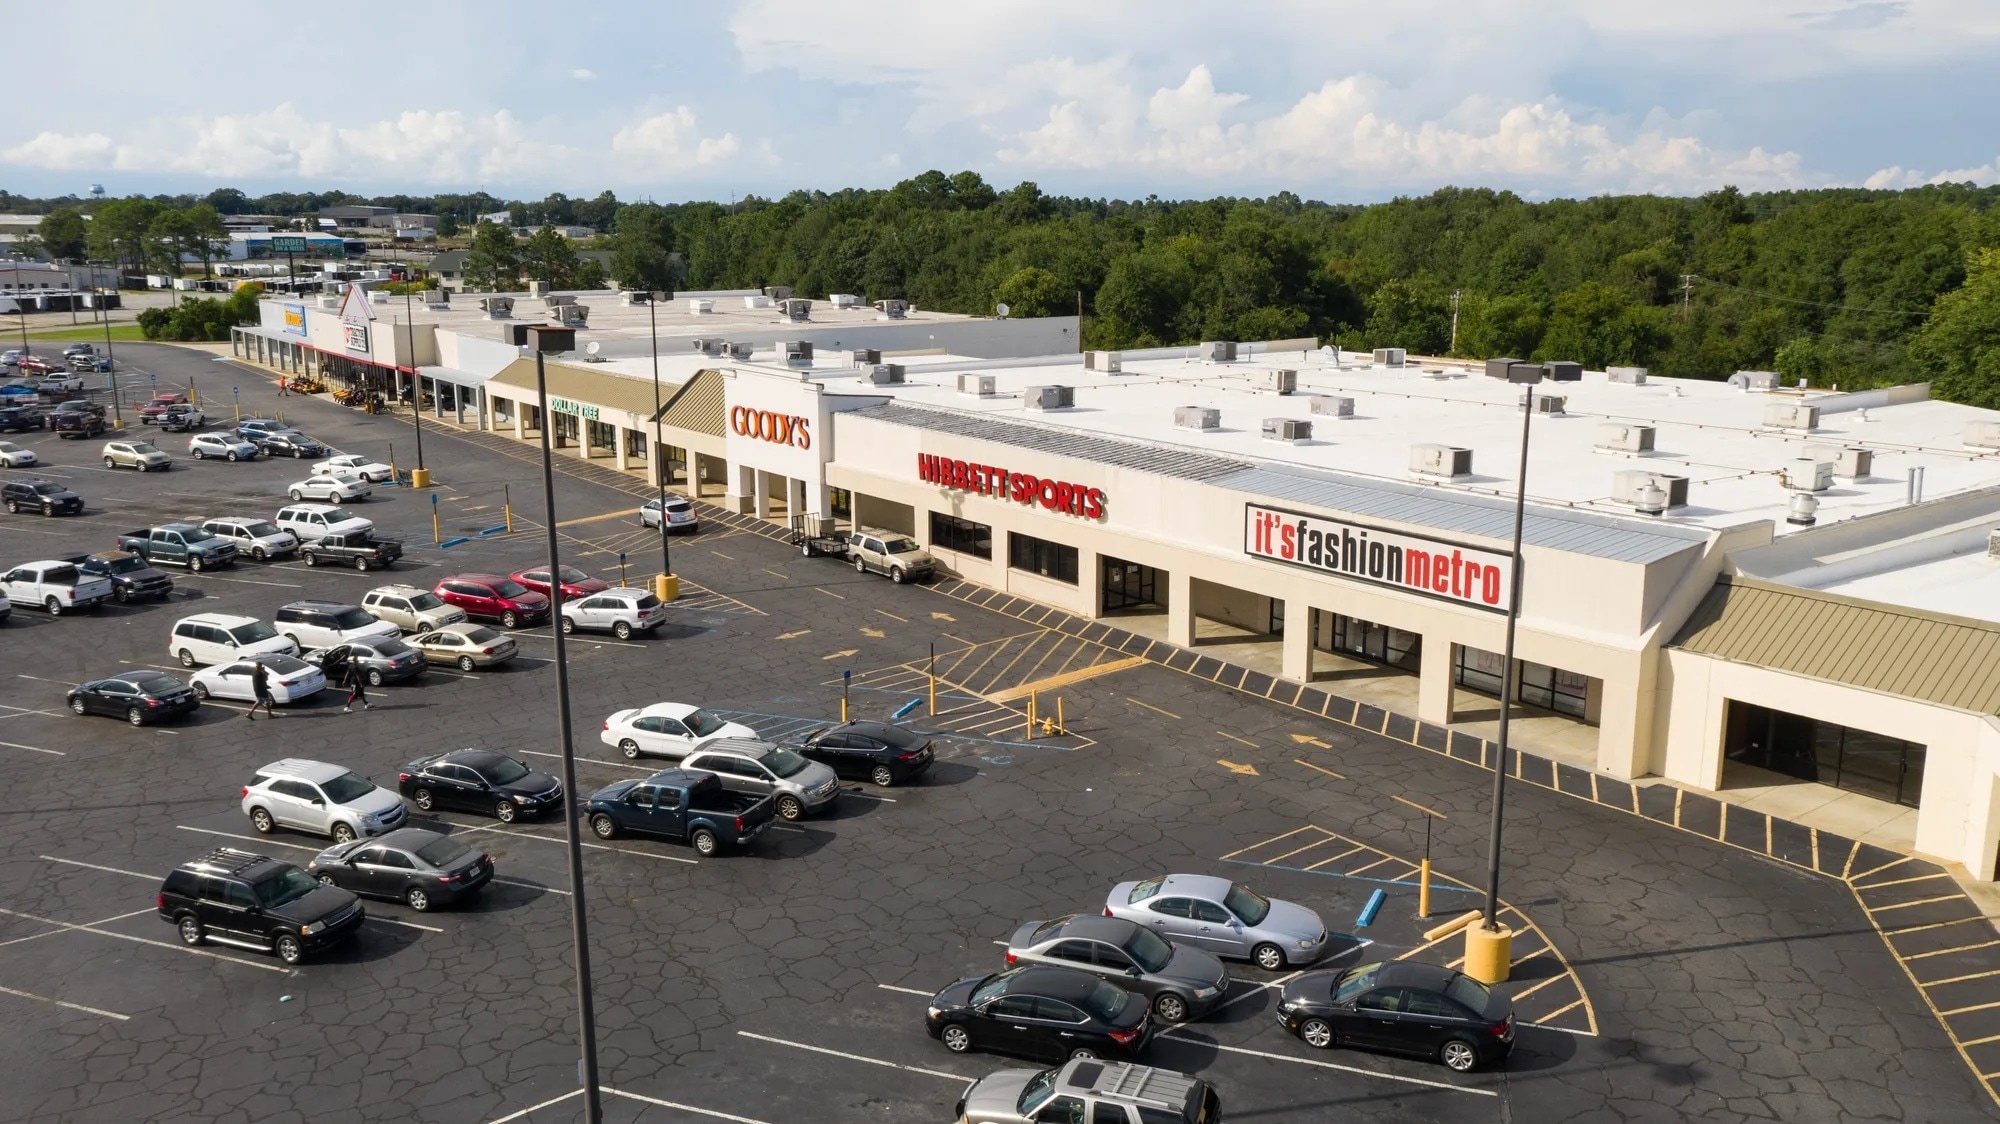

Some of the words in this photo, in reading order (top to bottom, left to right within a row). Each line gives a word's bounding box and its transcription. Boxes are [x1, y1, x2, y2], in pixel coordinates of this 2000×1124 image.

[274, 238, 305, 246] GARDEN
[552, 398, 580, 416] DOLLAR
[582, 405, 599, 420] TREE
[730, 405, 810, 450] GOODY'S
[918, 453, 1008, 498] HIBBETT
[1011, 473, 1103, 520] SPORTS
